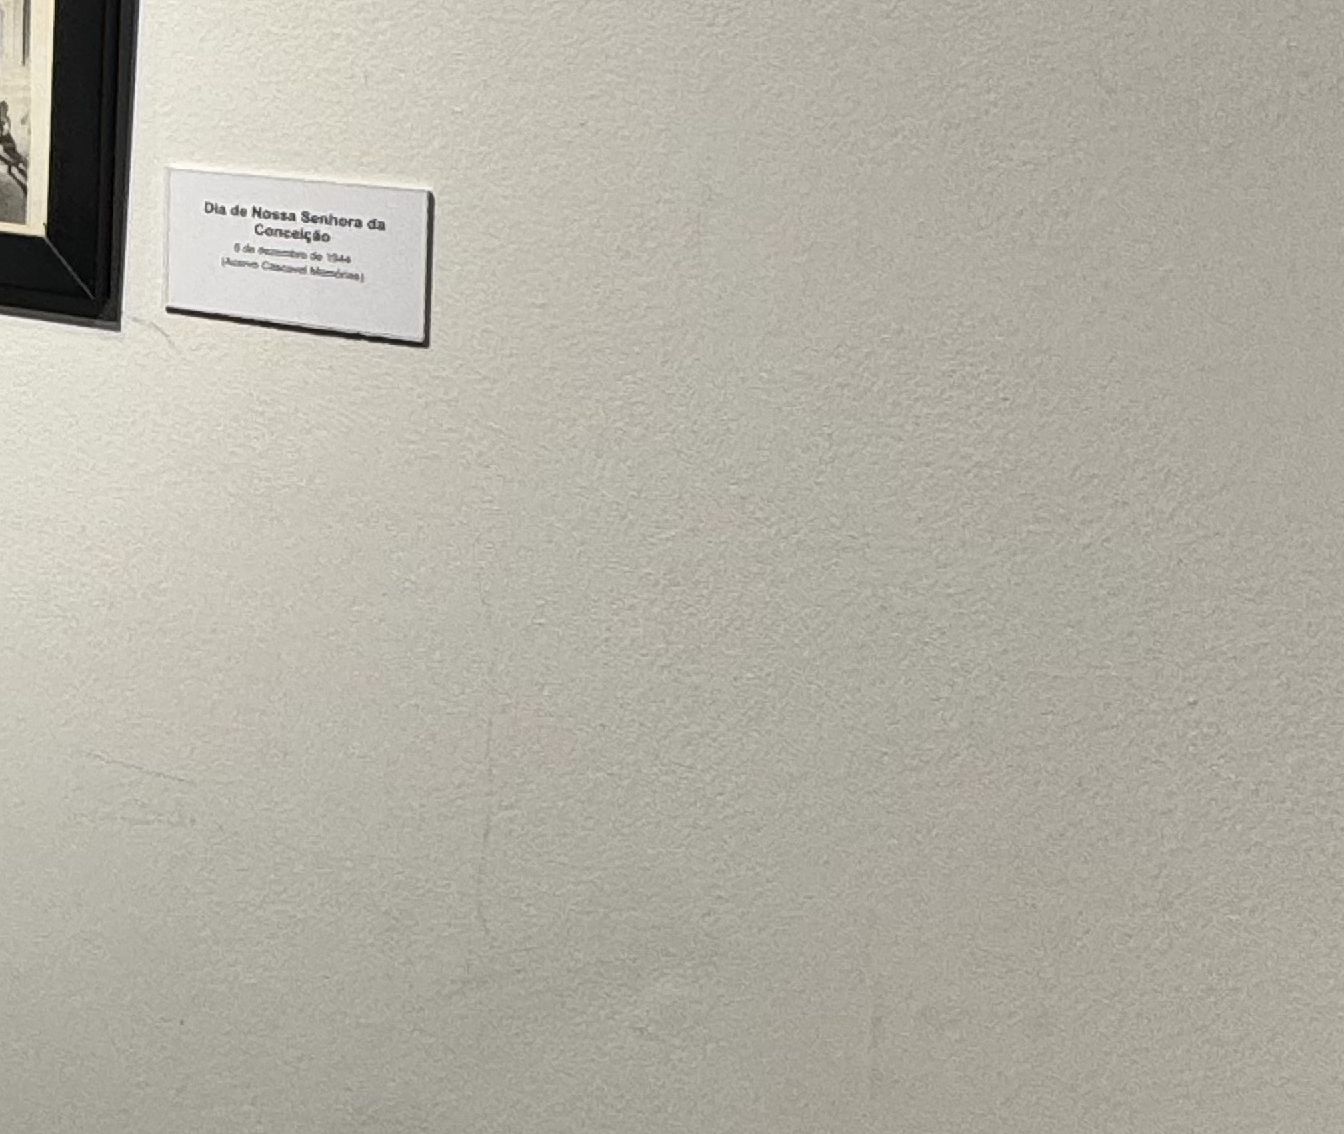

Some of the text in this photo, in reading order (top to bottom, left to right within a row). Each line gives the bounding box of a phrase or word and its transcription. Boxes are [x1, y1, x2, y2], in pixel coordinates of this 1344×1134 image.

[204, 201, 385, 231] Dia de Nossa Senhora da
[254, 223, 331, 243] Conceição
